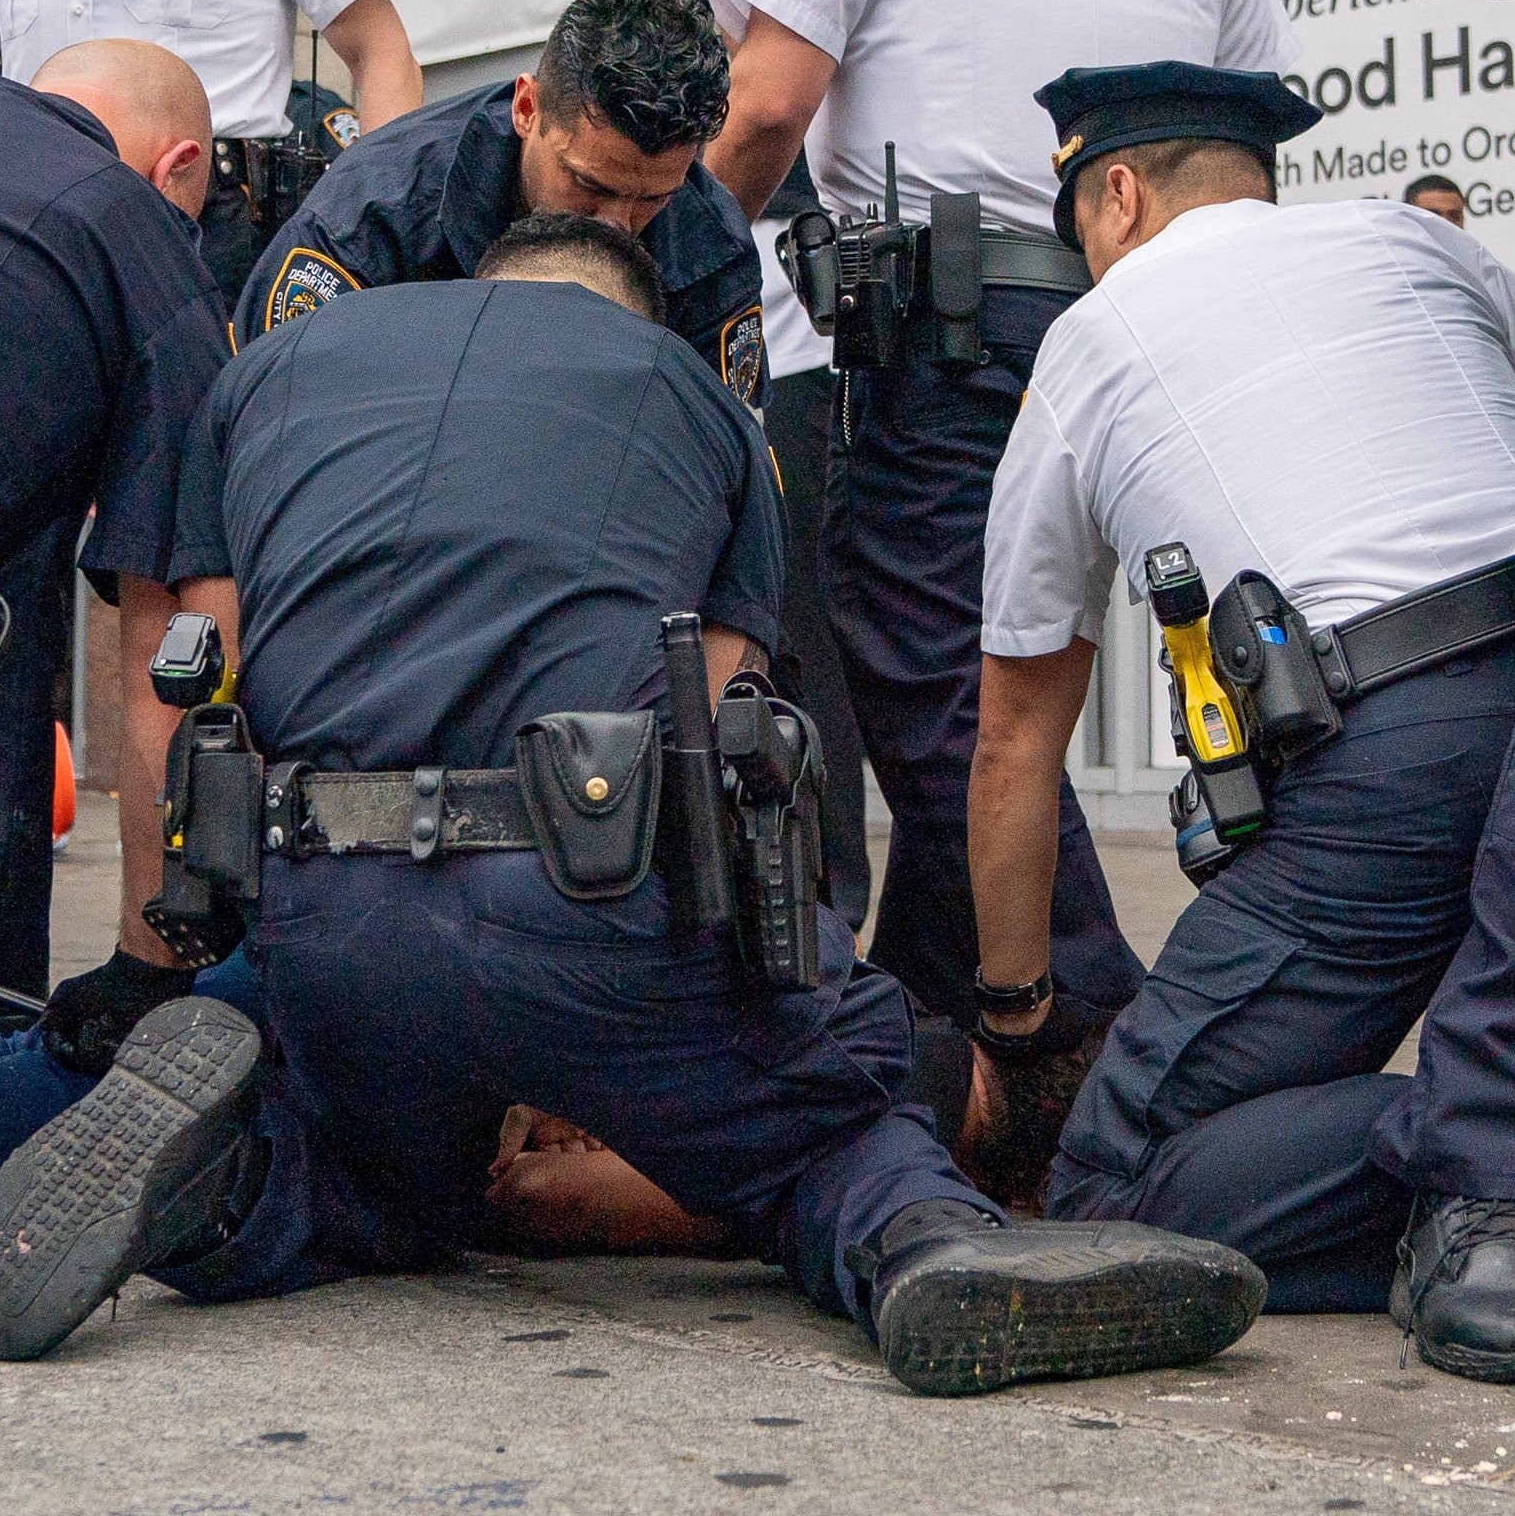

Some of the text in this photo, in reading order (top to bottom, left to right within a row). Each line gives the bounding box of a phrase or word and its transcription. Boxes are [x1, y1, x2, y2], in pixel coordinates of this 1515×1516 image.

[1312, 140, 1408, 184] Made
[1419, 137, 1452, 169] to
[287, 268, 338, 302] DEPARTME
[304, 261, 341, 291] POLICE
[273, 291, 284, 320] CITY
[1155, 551, 1185, 571] L2
